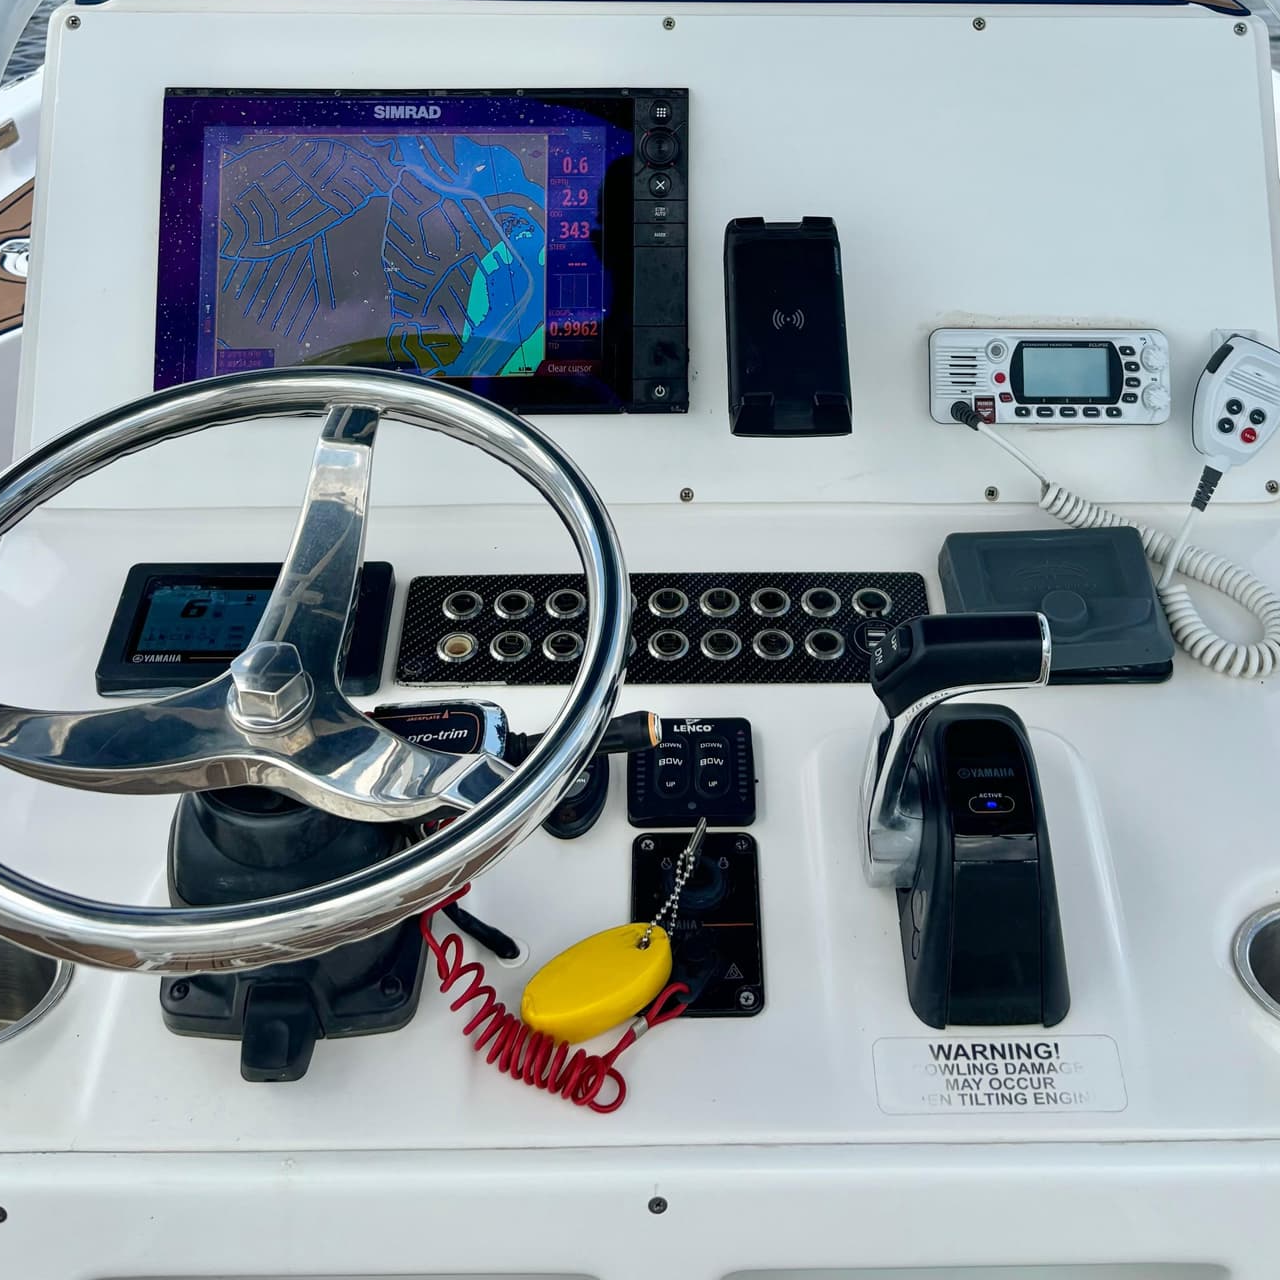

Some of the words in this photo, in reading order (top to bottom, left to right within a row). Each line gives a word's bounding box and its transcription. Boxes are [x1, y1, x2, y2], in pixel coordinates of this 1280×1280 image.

[374, 105, 442, 119] SIMRAD
[562, 156, 589, 174] 0.6
[562, 188, 589, 207] 2.9
[559, 221, 591, 239] 343
[549, 319, 599, 337] 0.9962
[547, 363, 567, 373] Clear
[568, 364, 593, 373] cursor
[181, 599, 212, 618] 6
[890, 633, 898, 651] UP
[144, 654, 181, 663] YAMAHA
[874, 647, 883, 665] DN
[407, 728, 468, 743] pro-trim
[673, 724, 712, 734] LENCO
[658, 757, 683, 767] BOW
[700, 757, 724, 766] BOW
[970, 767, 1015, 778] YAMAHA
[928, 1042, 1060, 1061] WARNING!
[915, 1062, 999, 1076] OWLING
[945, 1077, 983, 1091] MAY
[988, 1077, 1056, 1090] OCCUR
[958, 1092, 1028, 1106] TILTING
